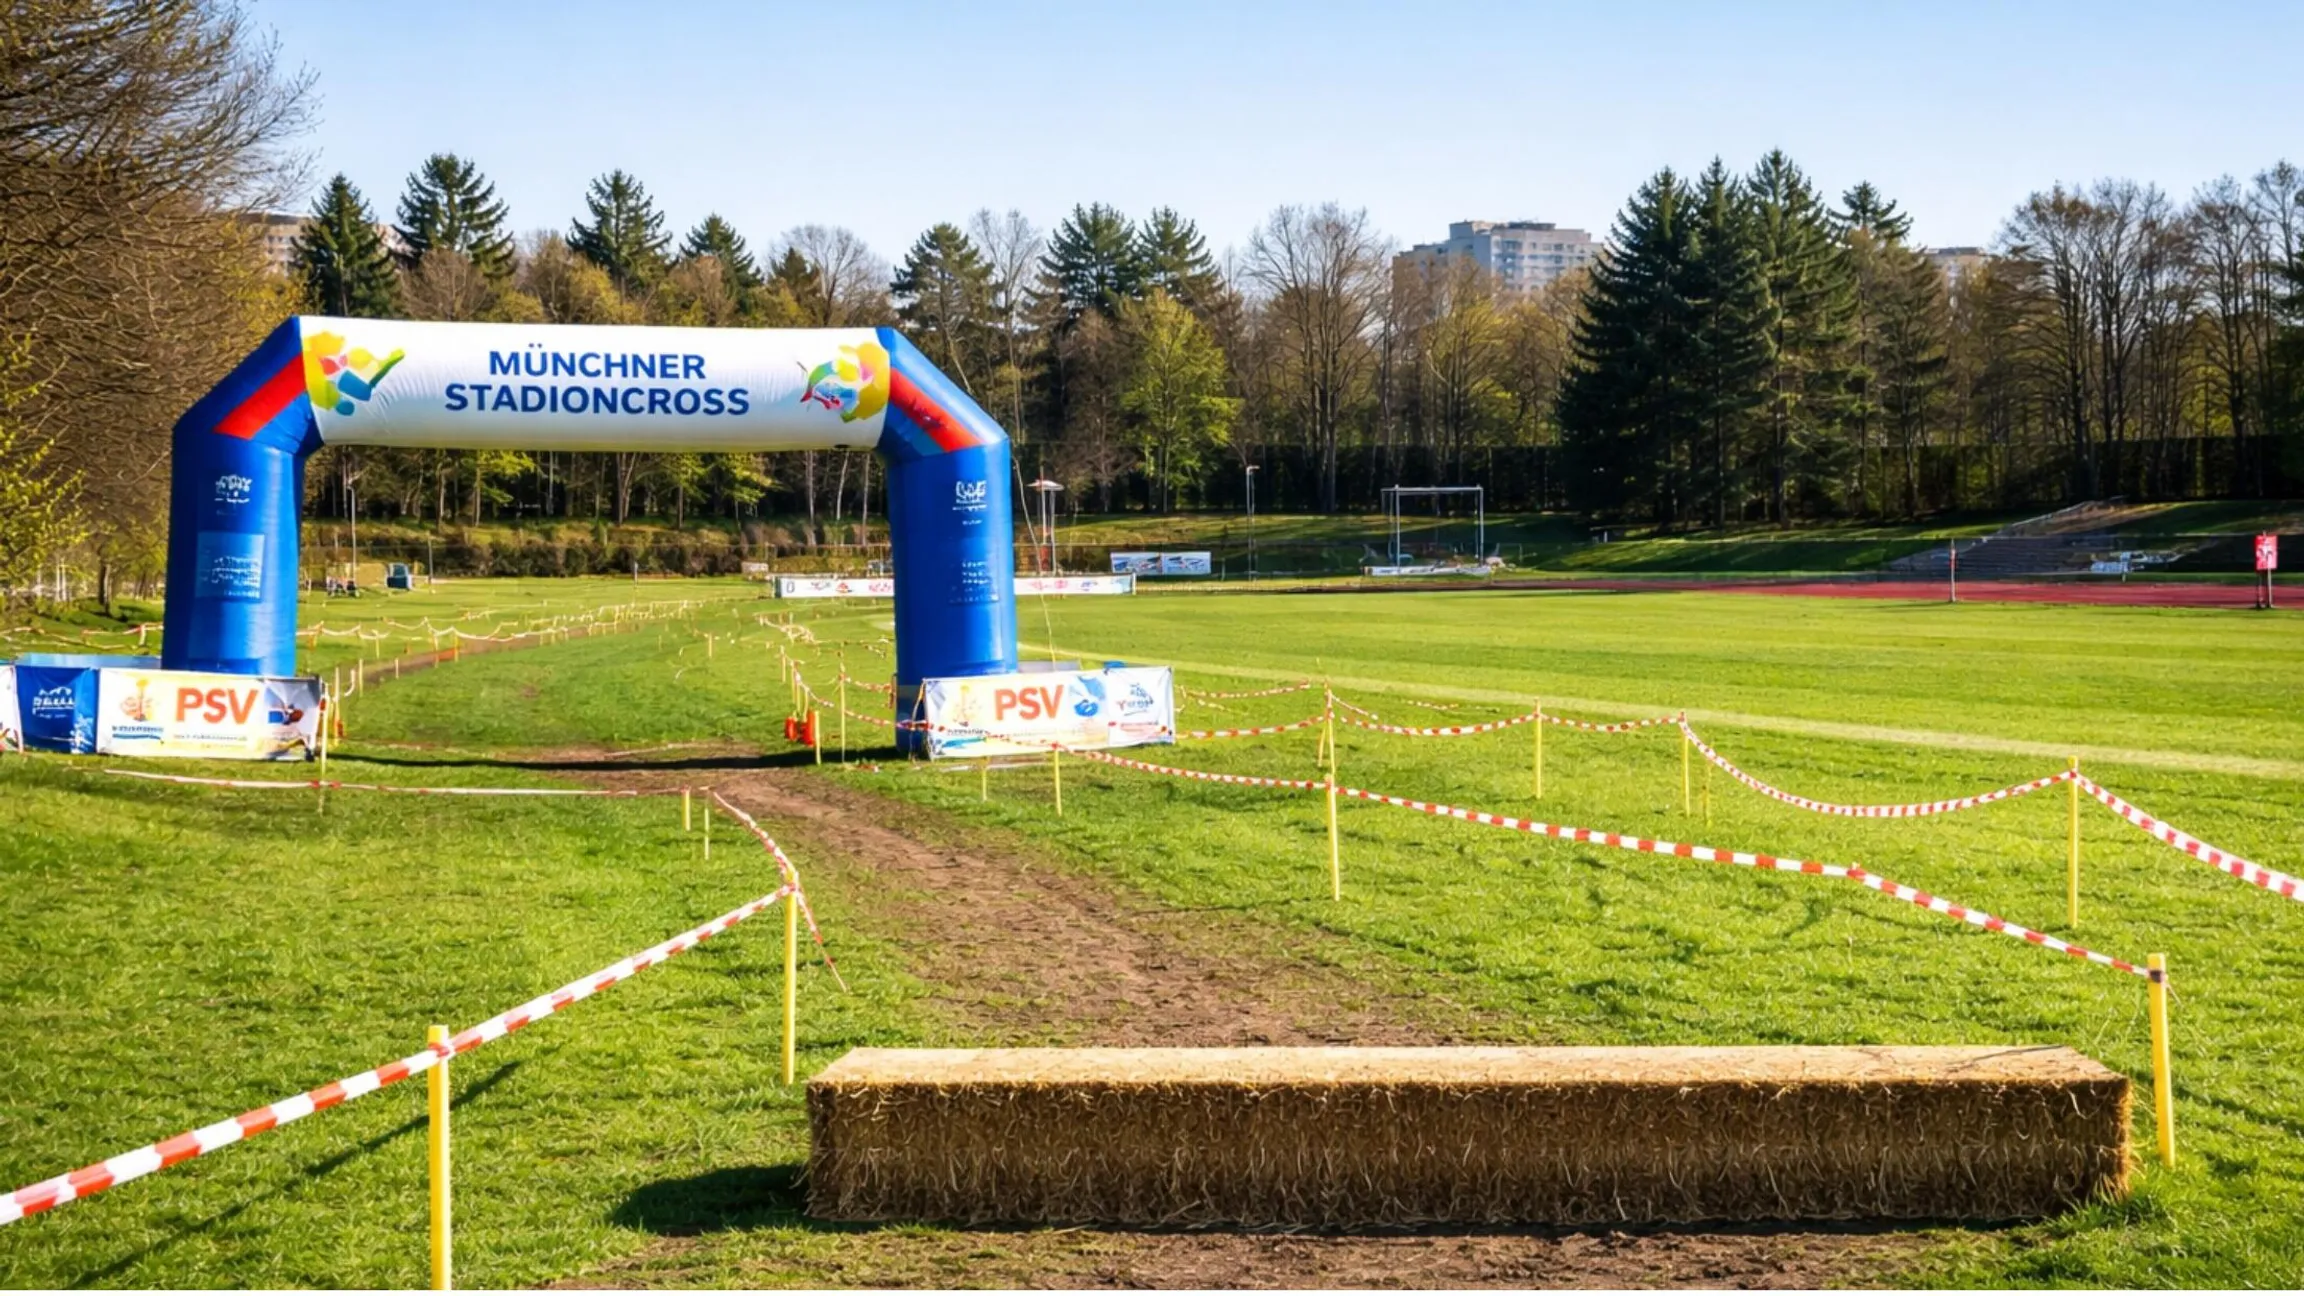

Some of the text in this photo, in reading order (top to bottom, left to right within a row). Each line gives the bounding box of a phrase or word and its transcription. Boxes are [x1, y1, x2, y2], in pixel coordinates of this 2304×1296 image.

[489, 343, 706, 379] MÜNCHNER
[445, 384, 749, 416] STADIONCROSS
[176, 688, 259, 724] PSV
[994, 685, 1064, 721] PSV
